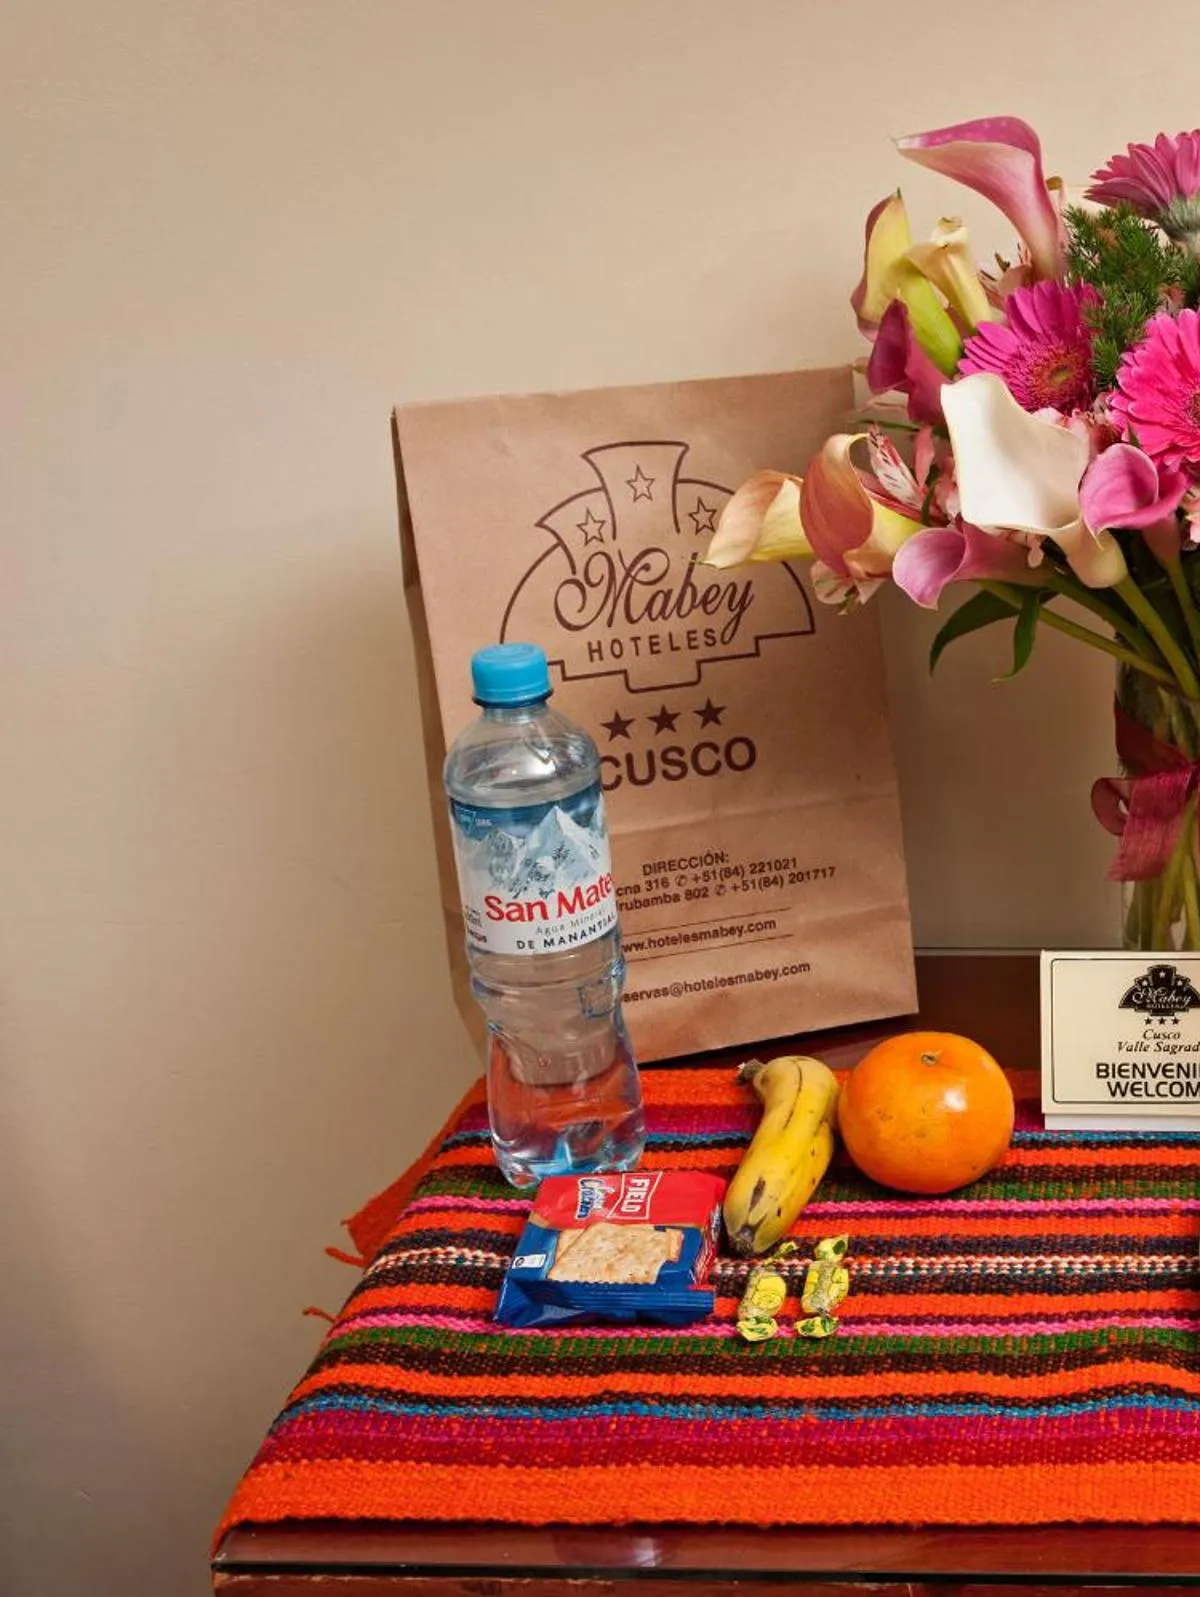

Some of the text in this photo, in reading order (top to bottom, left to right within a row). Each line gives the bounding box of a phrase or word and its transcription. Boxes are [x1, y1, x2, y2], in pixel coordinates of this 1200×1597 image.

[555, 547, 754, 645] Mabey
[586, 627, 718, 663] HOTELES
[600, 736, 757, 791] CUSCO
[642, 850, 730, 877] DIRECCIÓN:
[645, 877, 670, 892] 316
[692, 865, 745, 885] +51(84)
[749, 857, 798, 874] 221021
[484, 894, 549, 922] San
[556, 872, 614, 918] Mate
[684, 887, 710, 901] 802
[788, 866, 836, 885] 201717
[516, 939, 536, 950] DE
[620, 917, 777, 953] ww.hotelesmabey.com
[621, 961, 811, 1003] servas@hotelesmabey.com
[1117, 1040, 1150, 1053] Valle
[1143, 1029, 1181, 1041] Cusco
[621, 1178, 650, 1213] FIELD
